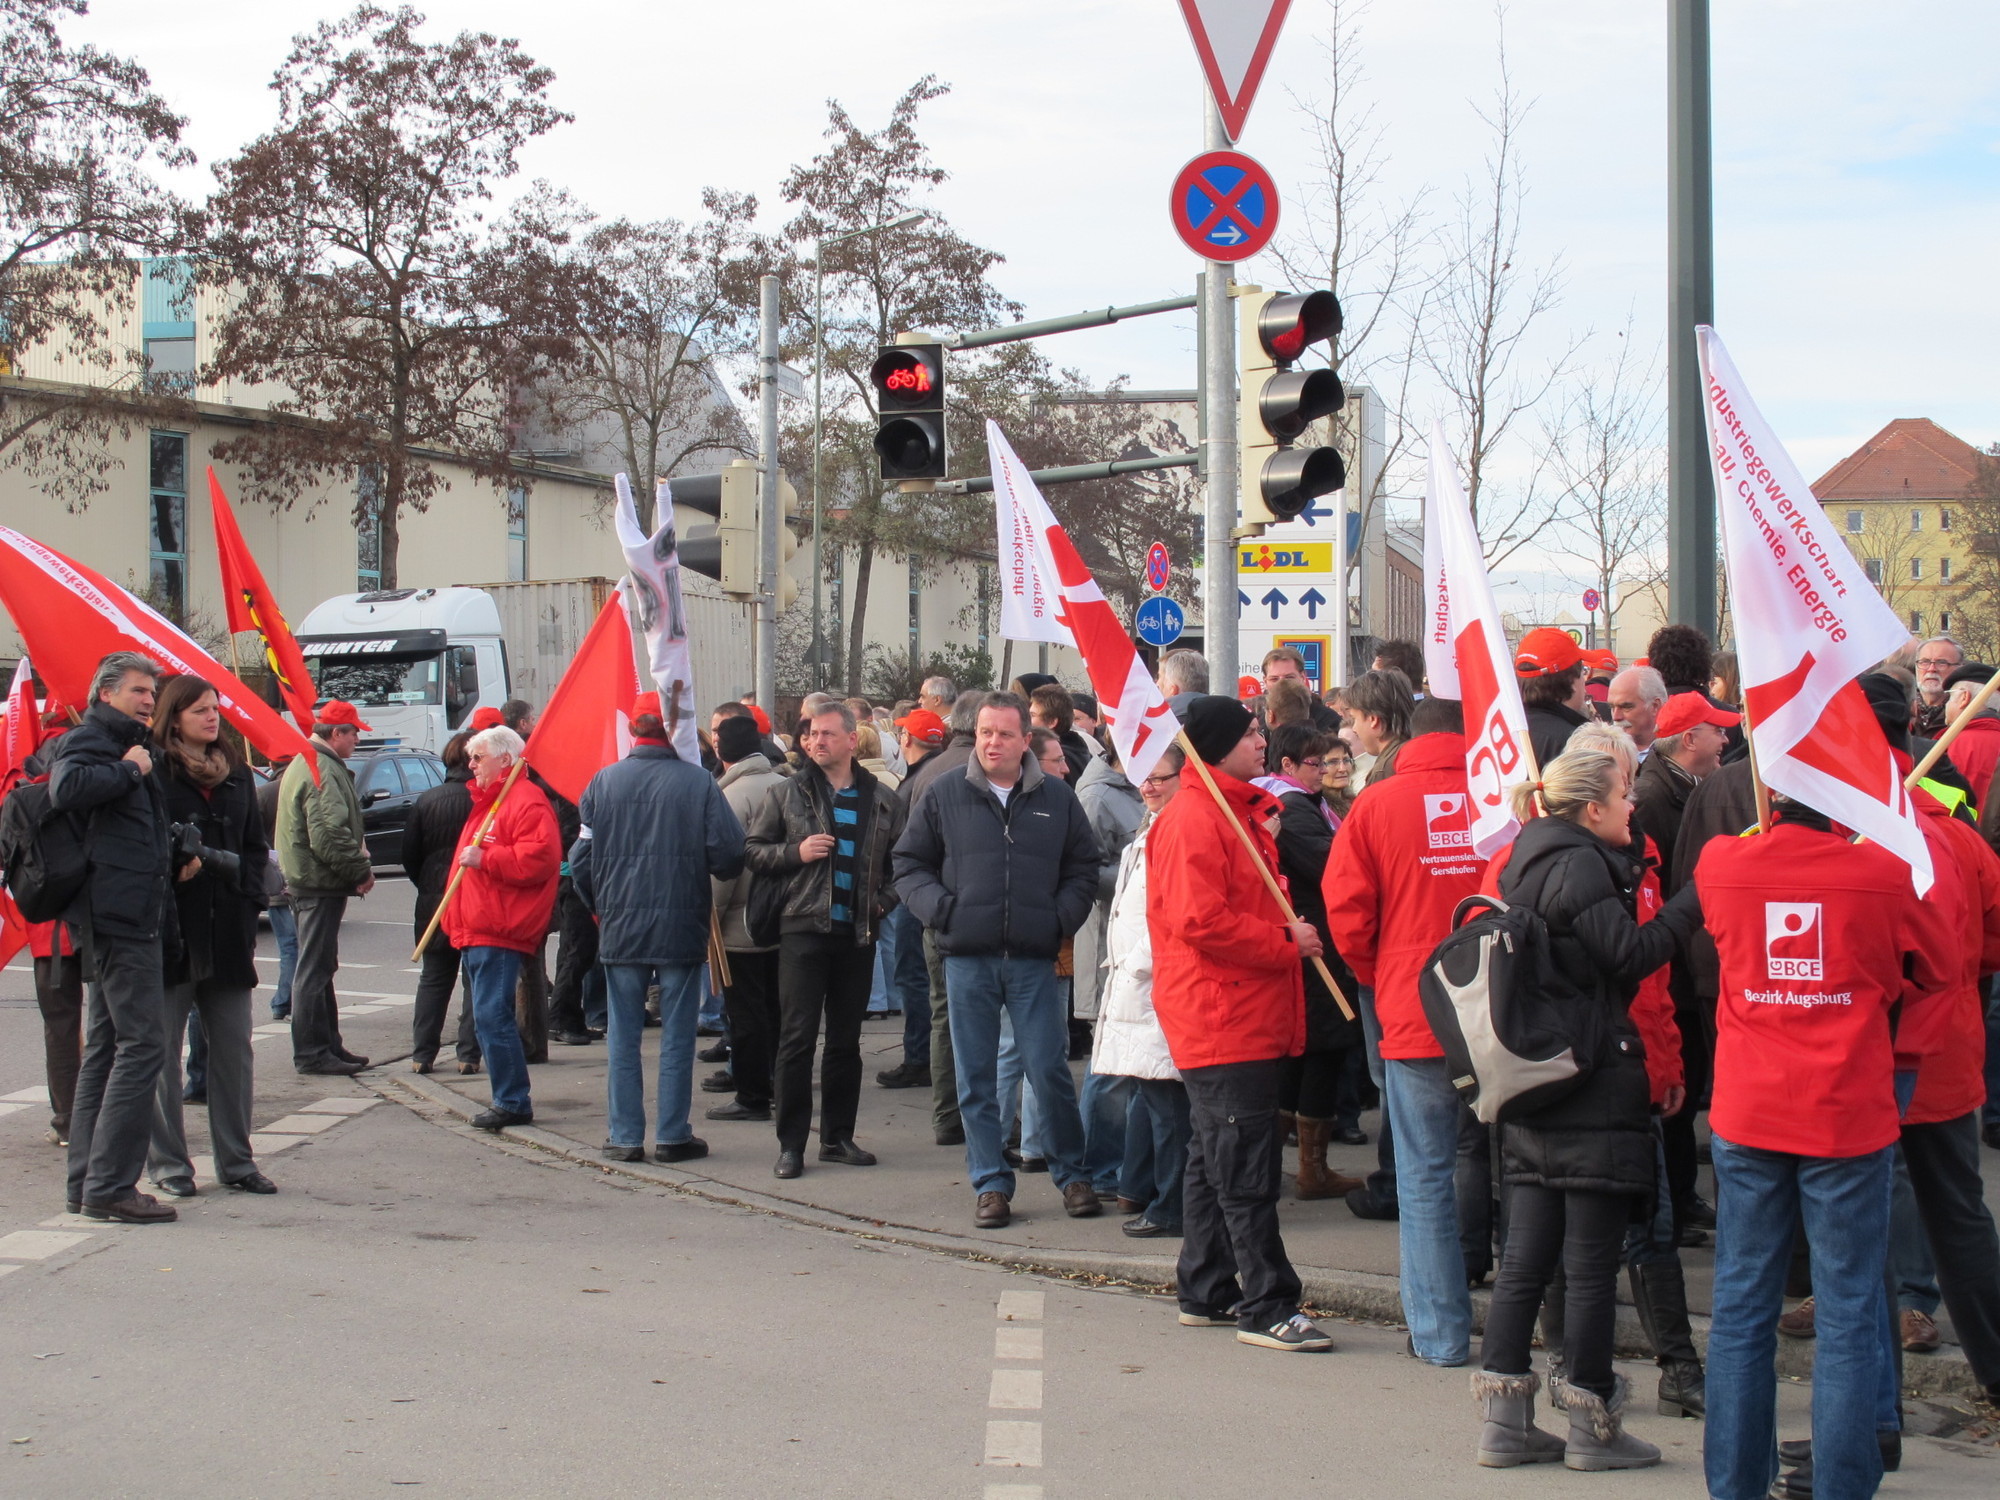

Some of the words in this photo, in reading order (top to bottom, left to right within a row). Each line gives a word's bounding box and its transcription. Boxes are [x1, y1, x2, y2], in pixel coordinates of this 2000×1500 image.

[1737, 479, 1786, 567] Chemie,
[1786, 563, 1848, 643] Energie
[1442, 832, 1470, 845] BCE
[1431, 865, 1477, 876] Gersthofen
[1784, 961, 1820, 977] BCE
[1744, 988, 1783, 1005] Bezirk
[1784, 991, 1852, 1008] Augsburg
